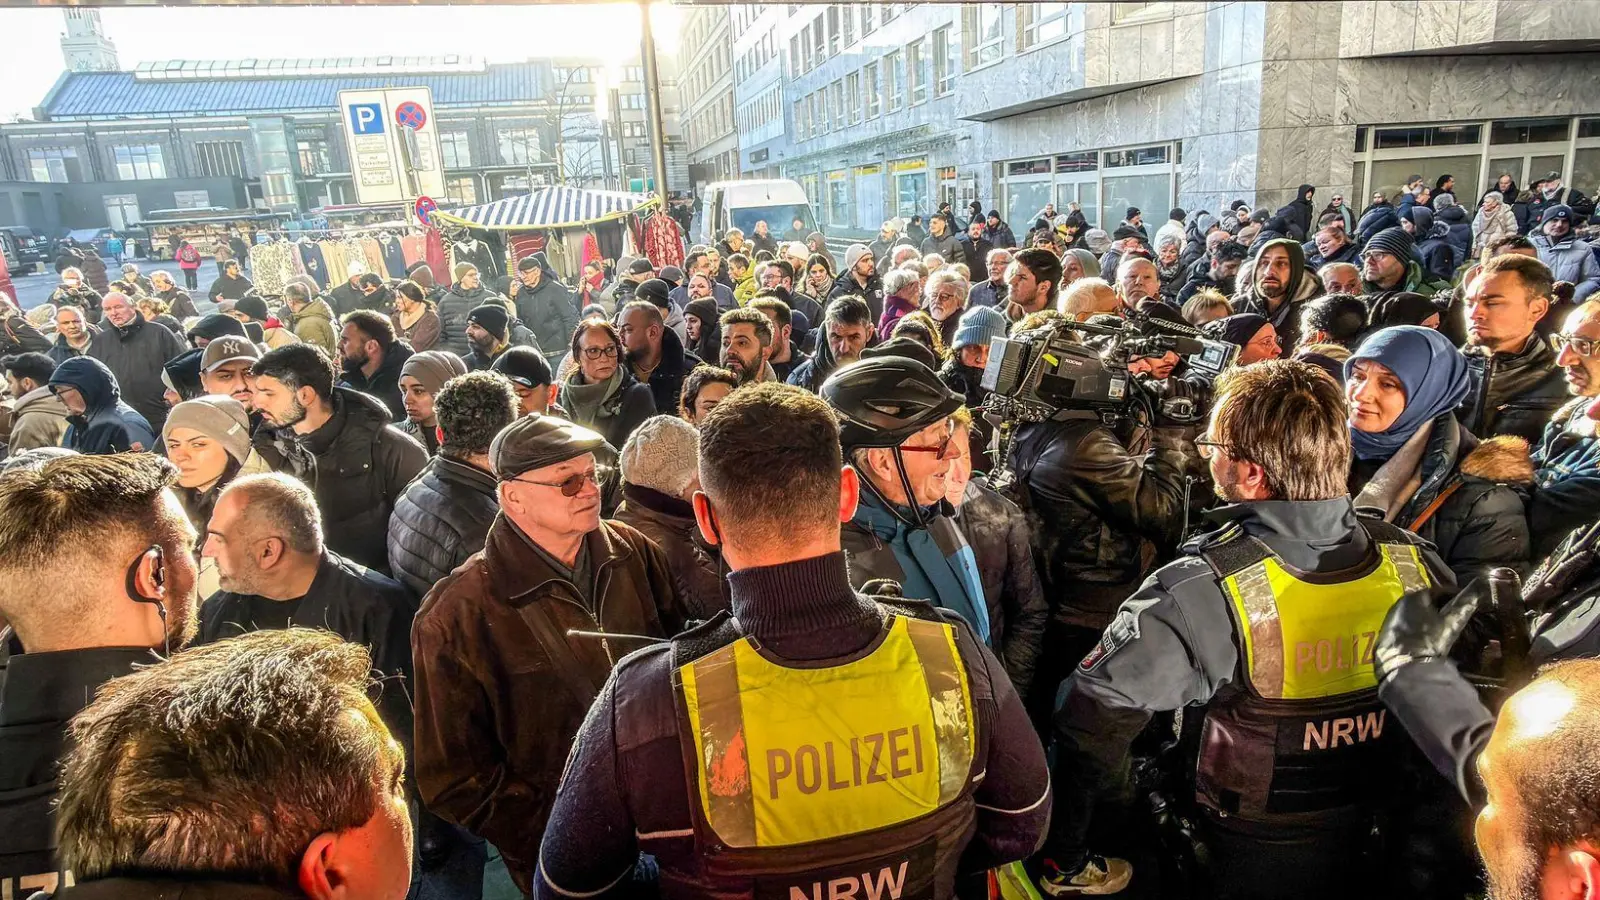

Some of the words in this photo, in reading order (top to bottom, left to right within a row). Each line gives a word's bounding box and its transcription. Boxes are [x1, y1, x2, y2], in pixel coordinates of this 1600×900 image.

[356, 107, 375, 132] P
[1295, 631, 1378, 675] POLIZ
[1303, 710, 1385, 751] NRW
[766, 724, 924, 800] POLIZEI
